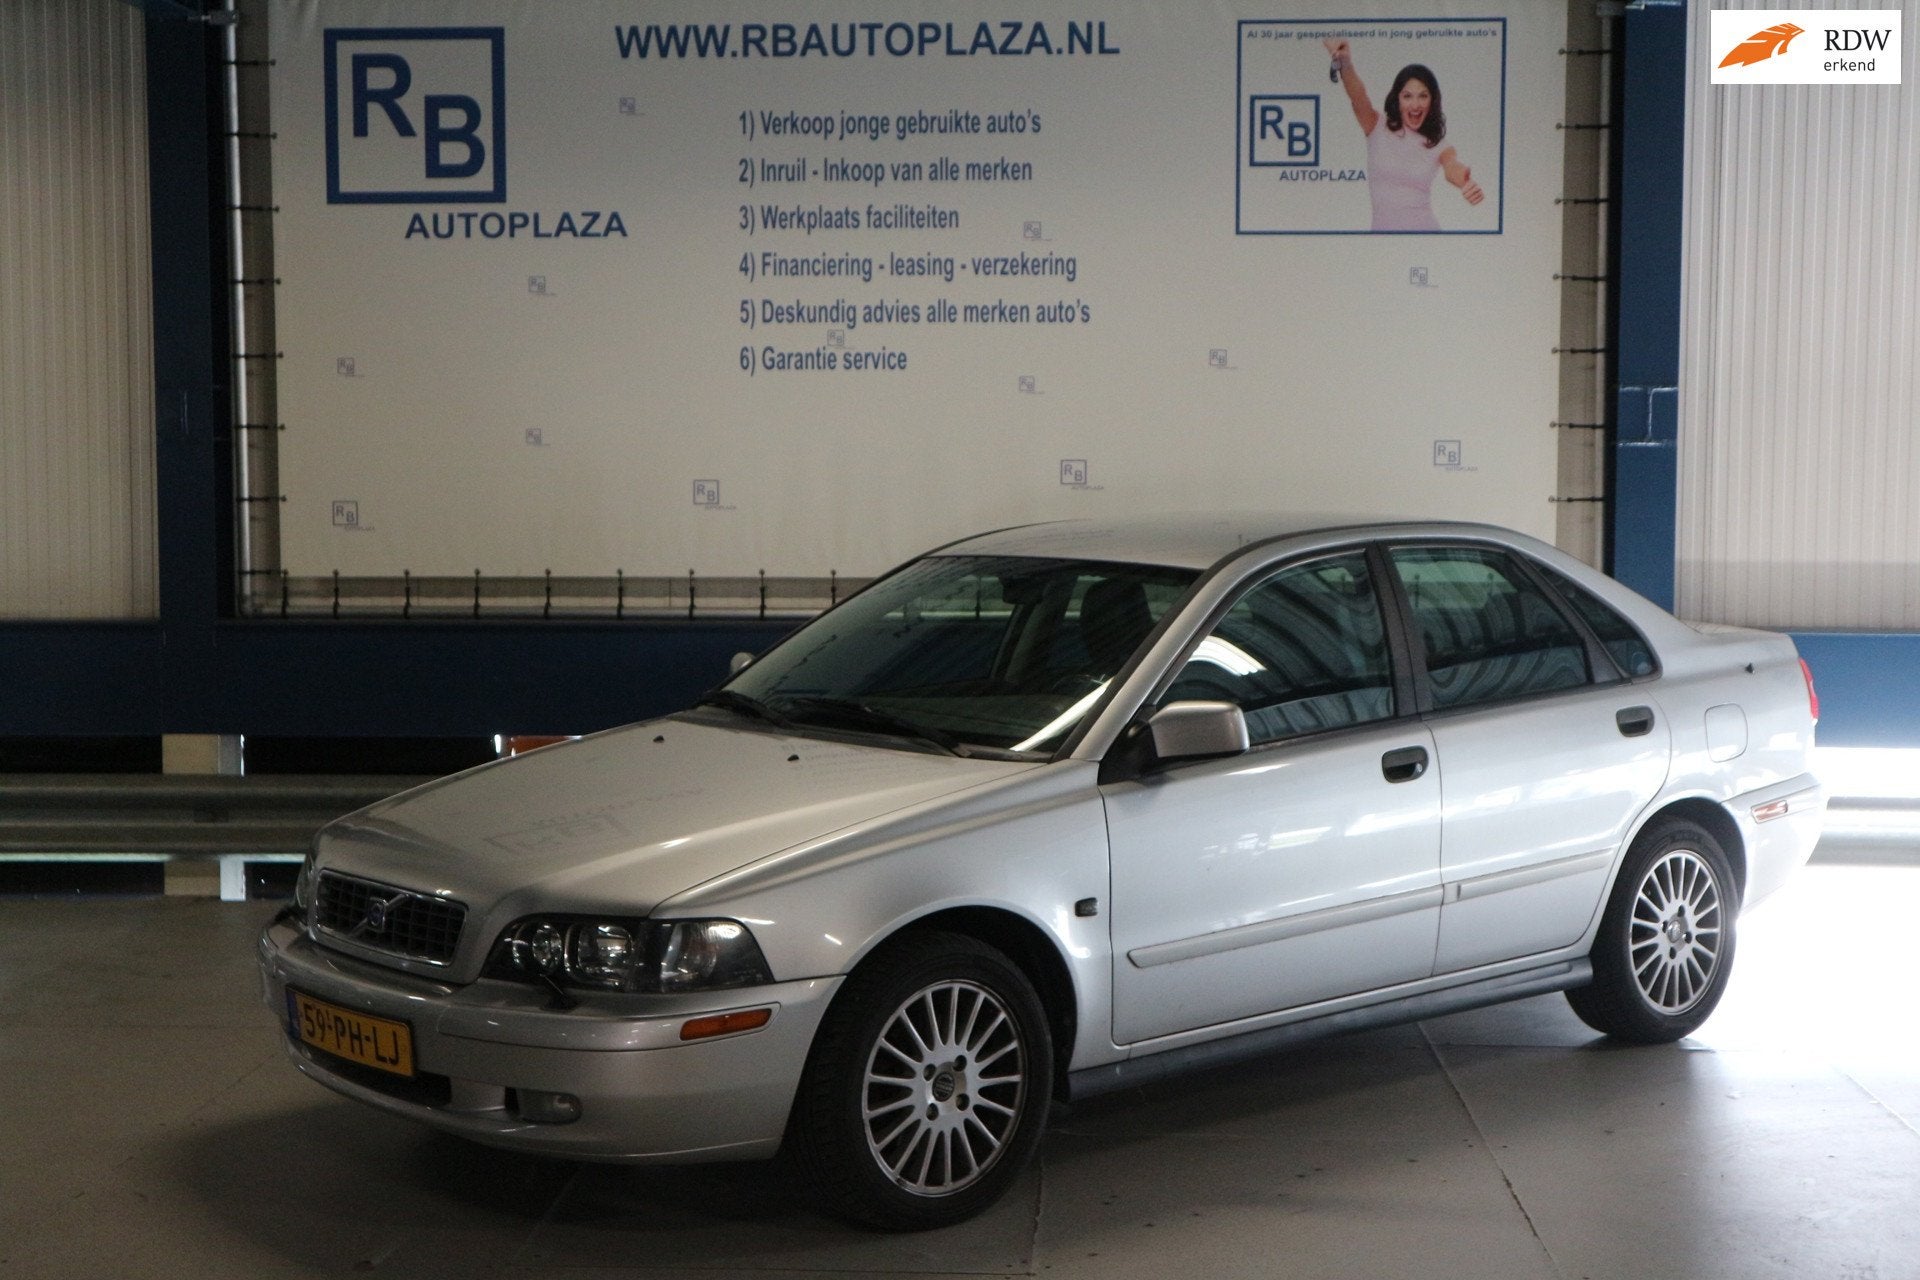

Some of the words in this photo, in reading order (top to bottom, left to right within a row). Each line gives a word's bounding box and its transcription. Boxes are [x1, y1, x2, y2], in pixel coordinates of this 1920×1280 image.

[615, 22, 1121, 60] WWW.RBAUTOPLAZA.NL
[1261, 30, 1272, 38] 30
[1275, 30, 1293, 39] jaar
[1296, 29, 1375, 40] gespecialiseerd
[1378, 30, 1387, 38] in
[1390, 29, 1413, 39] jong
[1416, 29, 1463, 39] gebruikte
[1466, 29, 1497, 38] auto's
[352, 54, 487, 180] RB
[739, 111, 757, 141] 1)
[760, 111, 836, 141] Verkoop
[840, 111, 892, 142] jonge
[896, 110, 982, 142] gebruikte
[1260, 105, 1312, 158] RB
[739, 159, 757, 189] 2)
[761, 158, 807, 184] Inruil
[824, 158, 886, 188] Inkoop
[891, 163, 924, 183] van
[929, 158, 961, 183] alle
[966, 158, 1034, 183] merken
[1279, 169, 1367, 182] AUTOPLAZA
[405, 212, 629, 240] AUTOPLAZA
[739, 206, 757, 236] 3)
[761, 205, 862, 236] Werkplaats
[866, 204, 961, 231] faciliteiten
[739, 253, 757, 283] 4)
[762, 252, 874, 283] Financiering
[890, 252, 956, 283] leasing
[972, 252, 1078, 283] verzekering
[740, 300, 757, 327] 5)
[762, 299, 858, 329] Deskundig
[863, 300, 922, 326] advies
[927, 299, 958, 325] alle
[964, 299, 1031, 325] merken
[740, 347, 757, 377] 6)
[762, 346, 839, 373] Garantie
[843, 347, 909, 372] service
